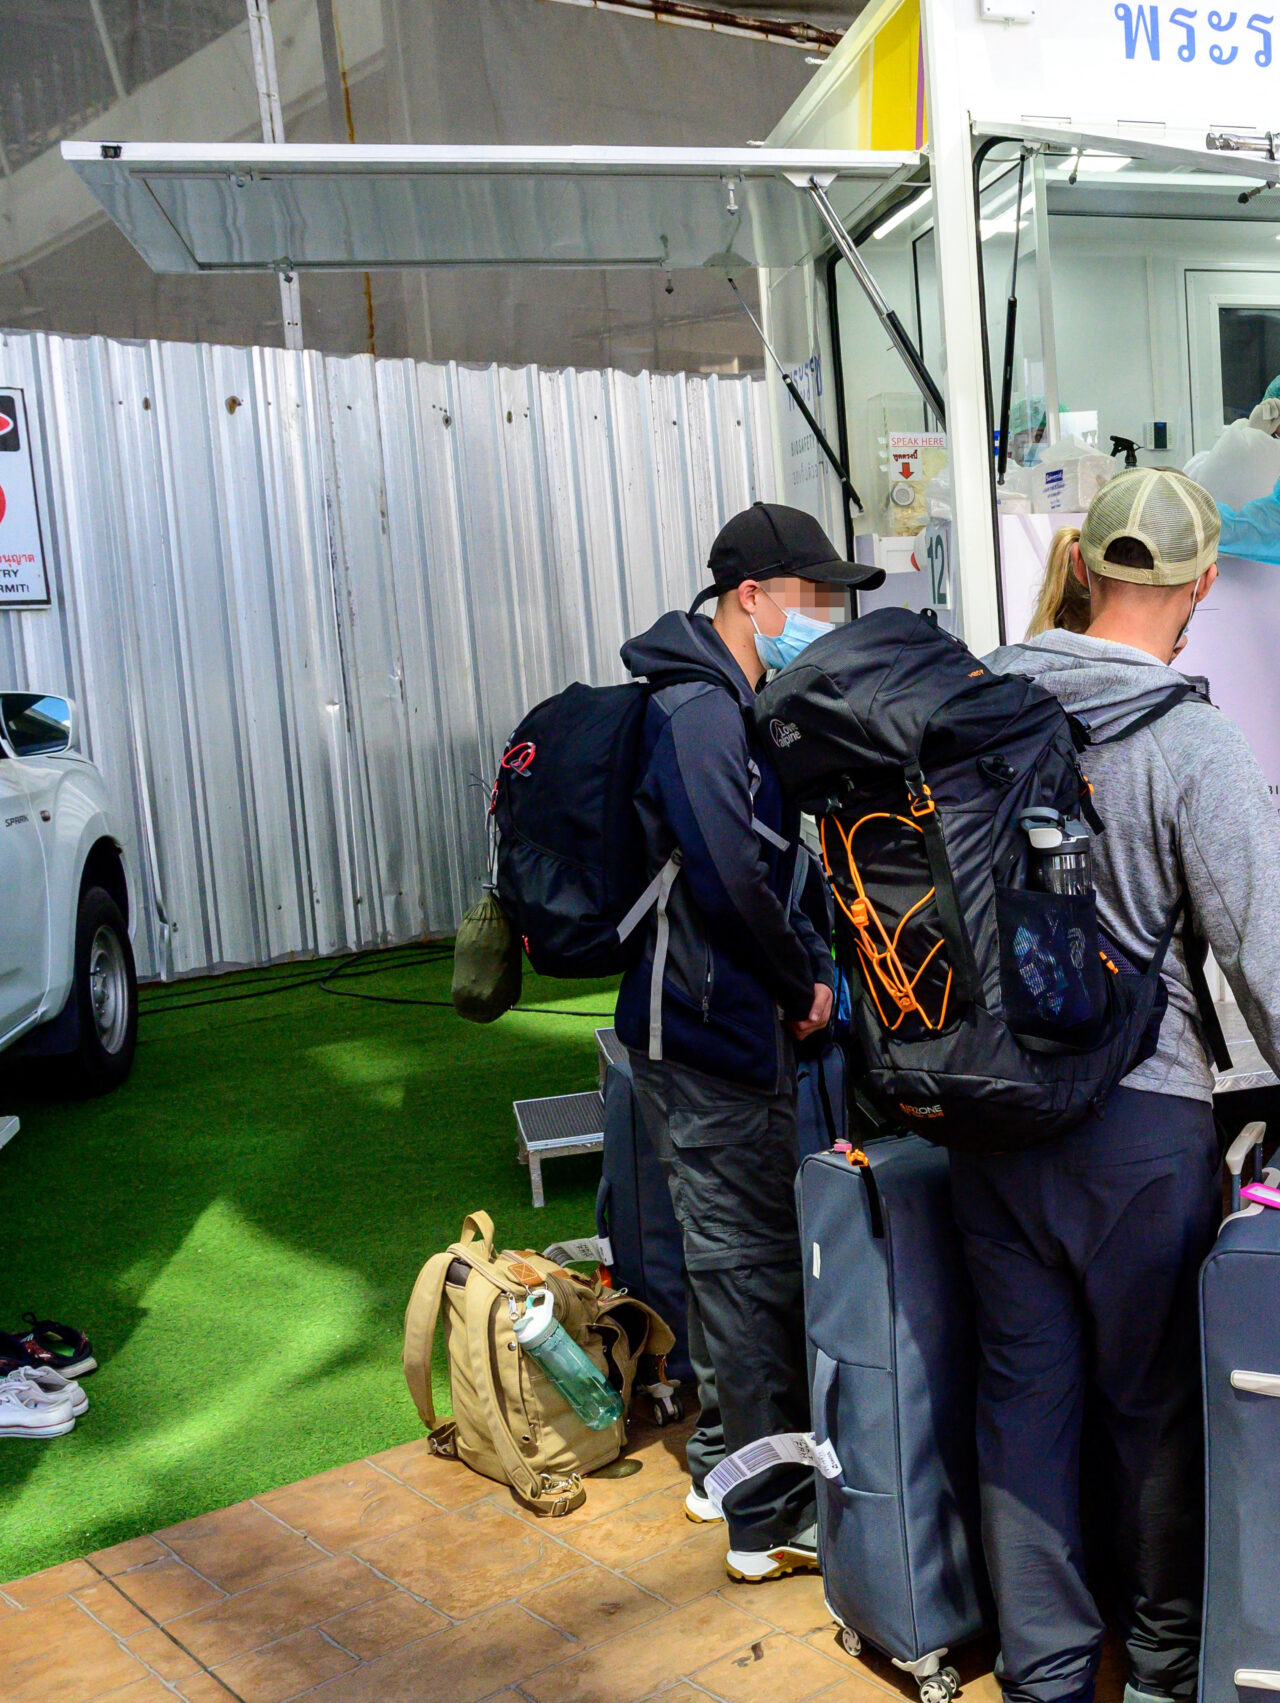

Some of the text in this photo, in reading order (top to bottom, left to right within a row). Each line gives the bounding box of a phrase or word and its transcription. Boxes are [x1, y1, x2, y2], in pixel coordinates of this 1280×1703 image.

[891, 436, 944, 446] SPEAK HERE
[927, 534, 947, 605] 12
[778, 730, 802, 748] alpine
[5, 815, 29, 828] SPARK
